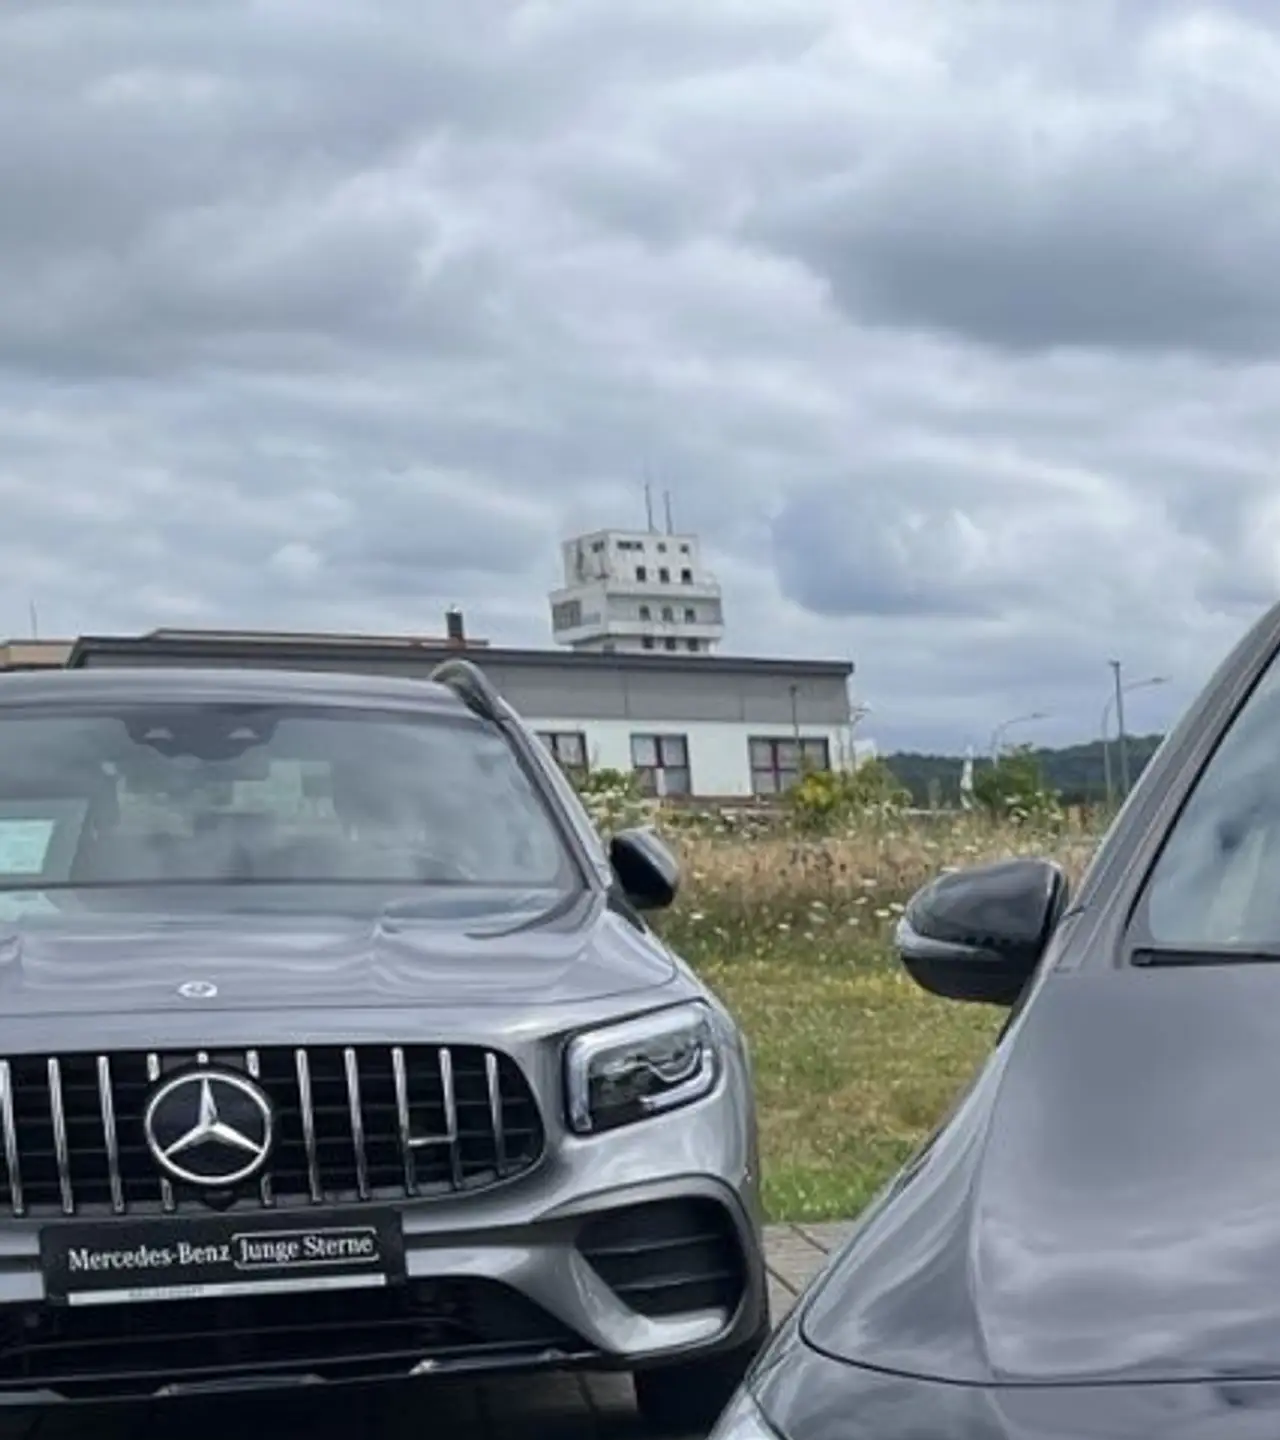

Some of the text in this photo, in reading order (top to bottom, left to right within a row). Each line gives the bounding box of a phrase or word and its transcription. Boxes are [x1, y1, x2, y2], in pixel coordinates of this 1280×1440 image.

[67, 1234, 374, 1272] Mercedes-Benz Junge Sterne
